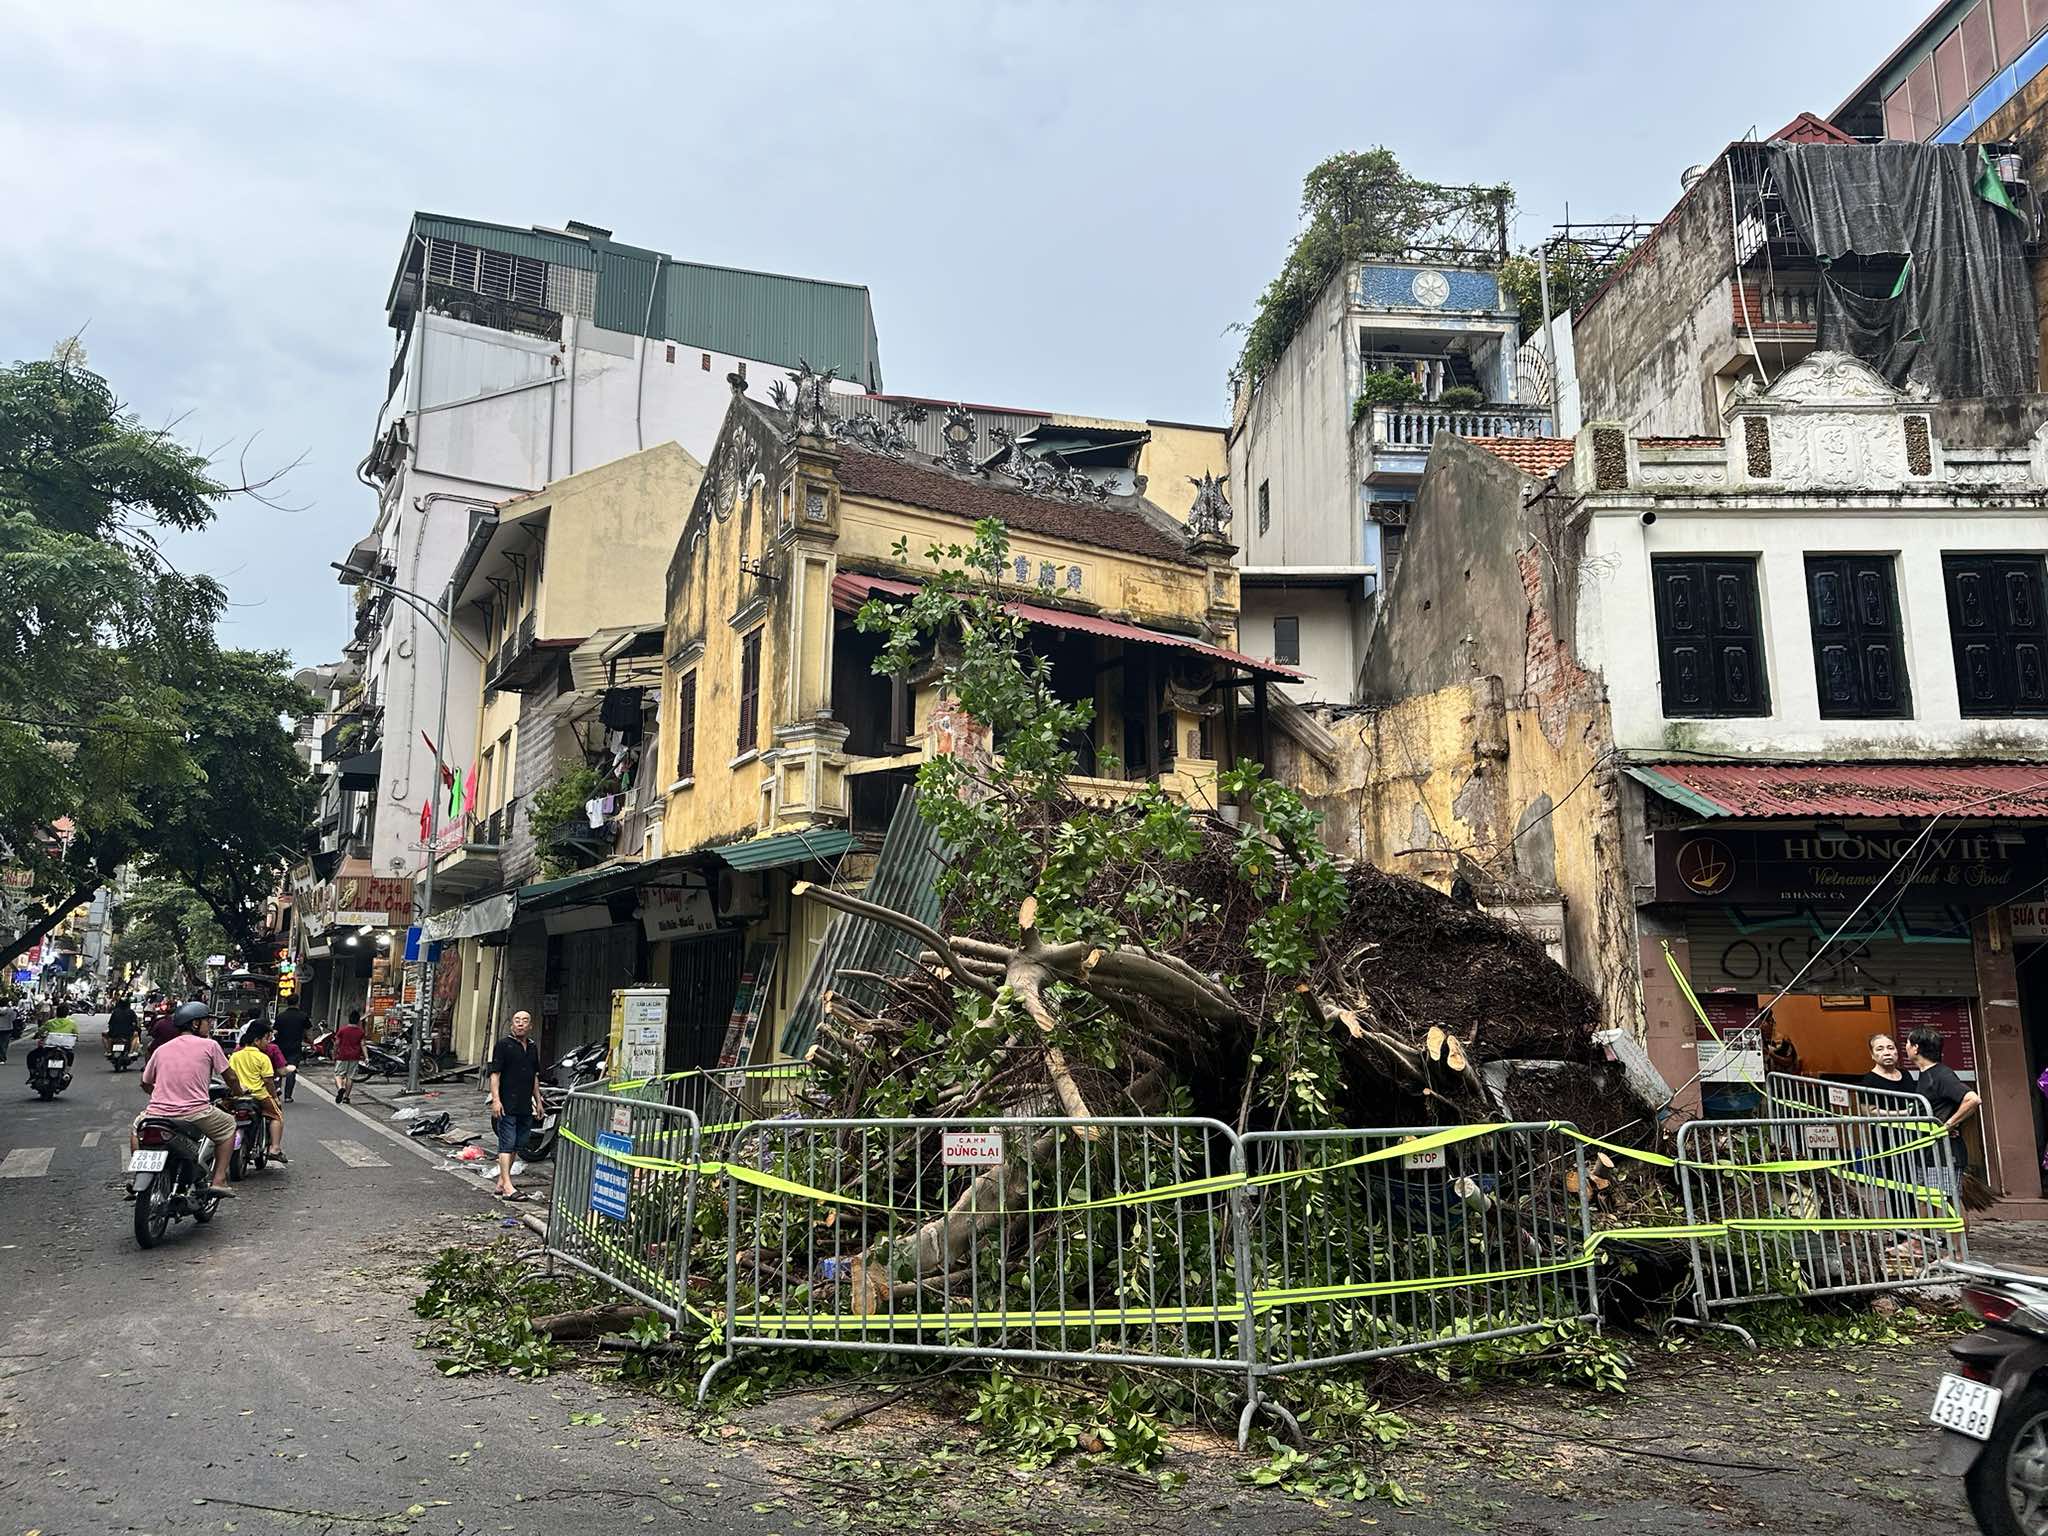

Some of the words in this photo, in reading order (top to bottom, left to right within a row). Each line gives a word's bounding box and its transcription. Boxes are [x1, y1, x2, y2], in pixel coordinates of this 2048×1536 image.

[946, 1144, 978, 1157] DỪNG
[980, 1147, 999, 1159] LẠI
[1412, 1153, 1438, 1164] STOP
[1944, 1379, 1990, 1410] 29-F1
